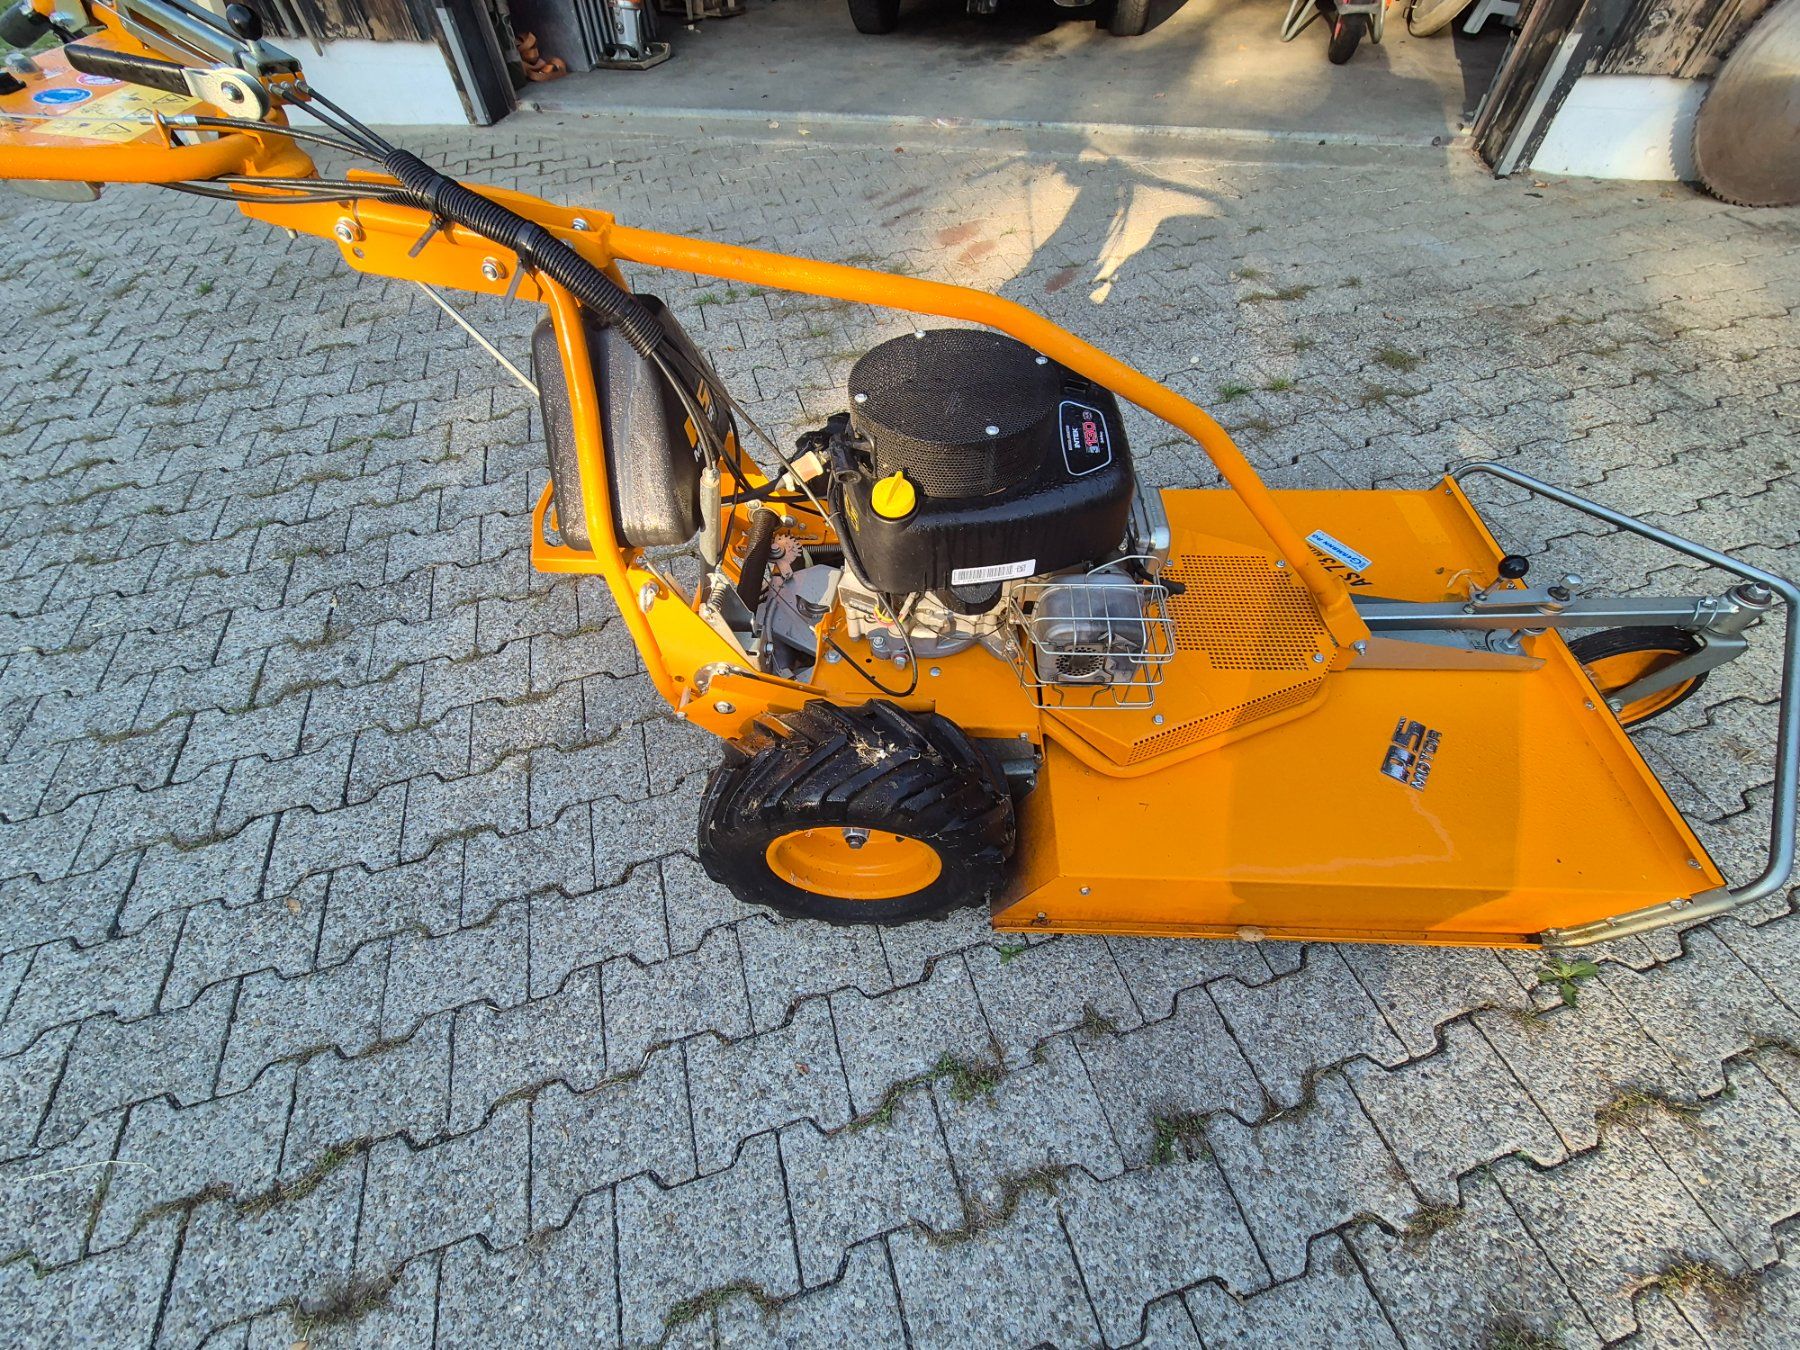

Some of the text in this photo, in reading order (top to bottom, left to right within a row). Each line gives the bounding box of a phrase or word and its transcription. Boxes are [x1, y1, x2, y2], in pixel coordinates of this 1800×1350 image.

[1072, 427, 1081, 449] INTEK
[1318, 557, 1346, 573] 73
[1339, 572, 1373, 587] AS
[1380, 716, 1426, 784] AS
[1410, 729, 1442, 792] MOTOR
